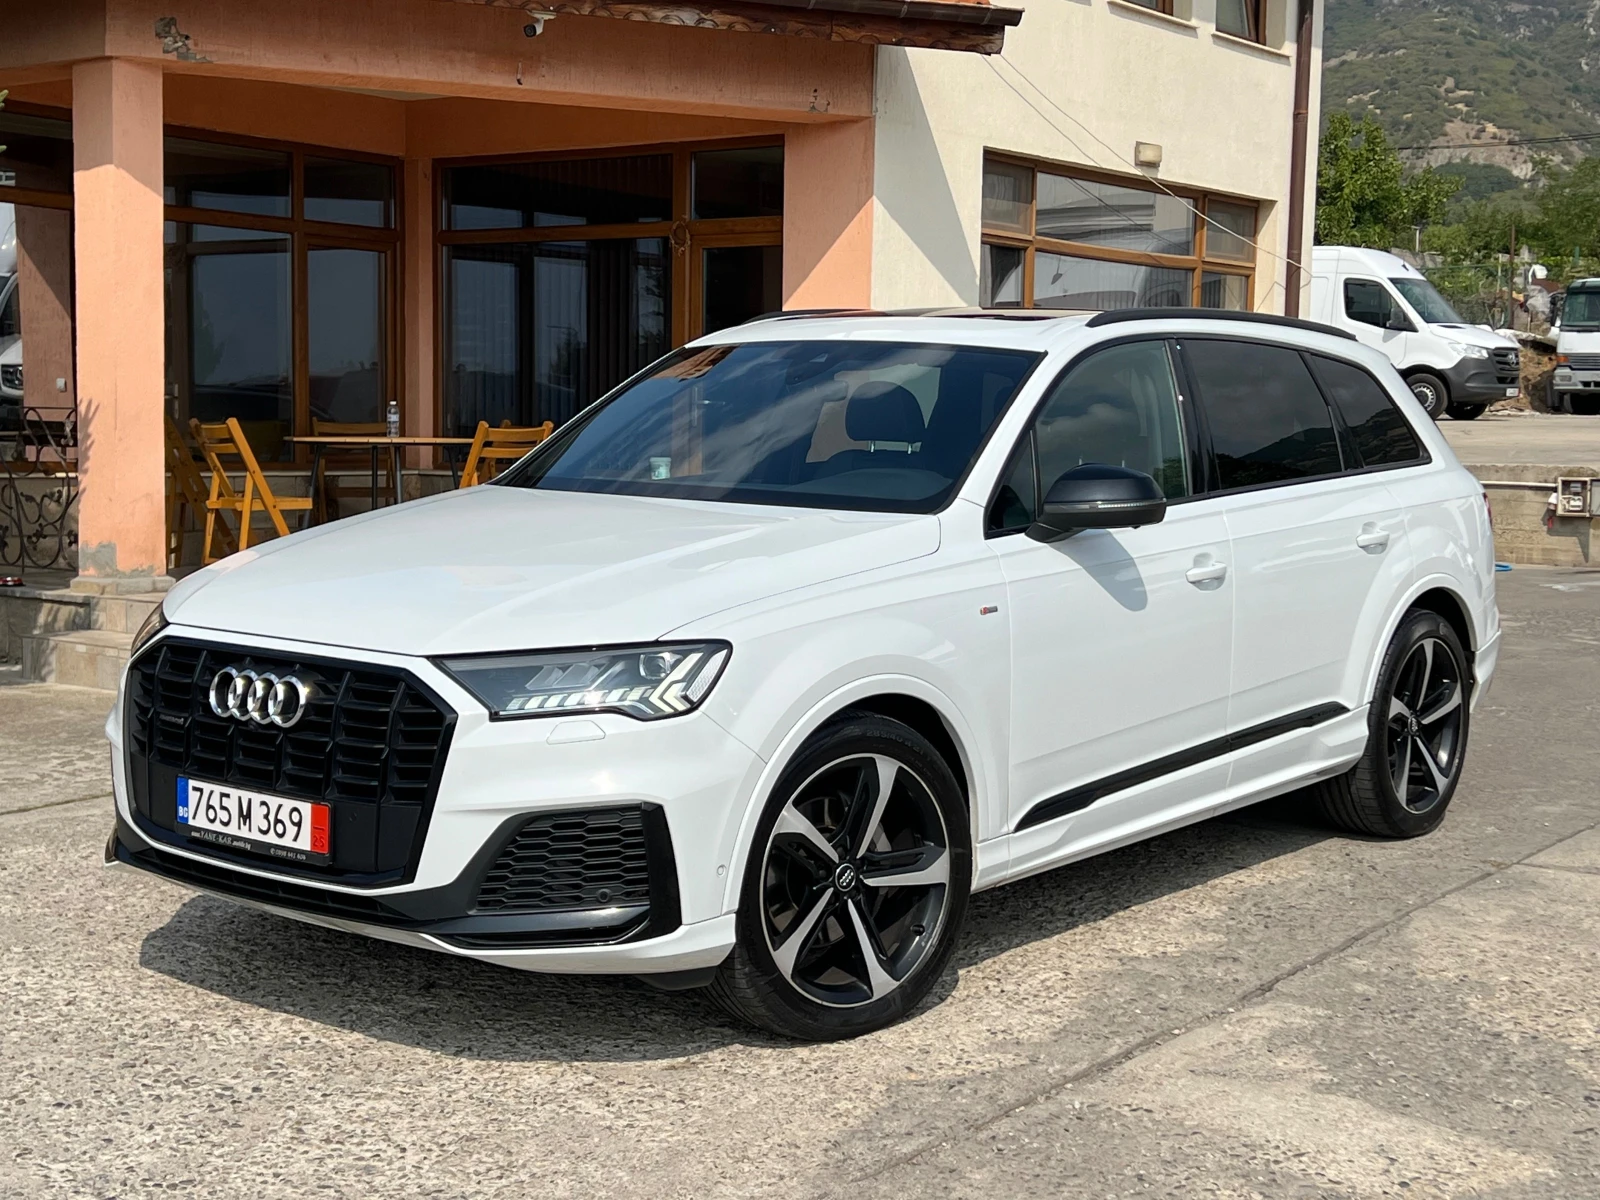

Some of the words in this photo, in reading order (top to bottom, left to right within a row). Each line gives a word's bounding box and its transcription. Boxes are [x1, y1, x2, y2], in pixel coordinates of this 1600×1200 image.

[178, 805, 188, 818] BG
[191, 785, 232, 828] 765
[238, 795, 252, 833] M
[257, 800, 303, 842] 369
[312, 834, 325, 848] 25
